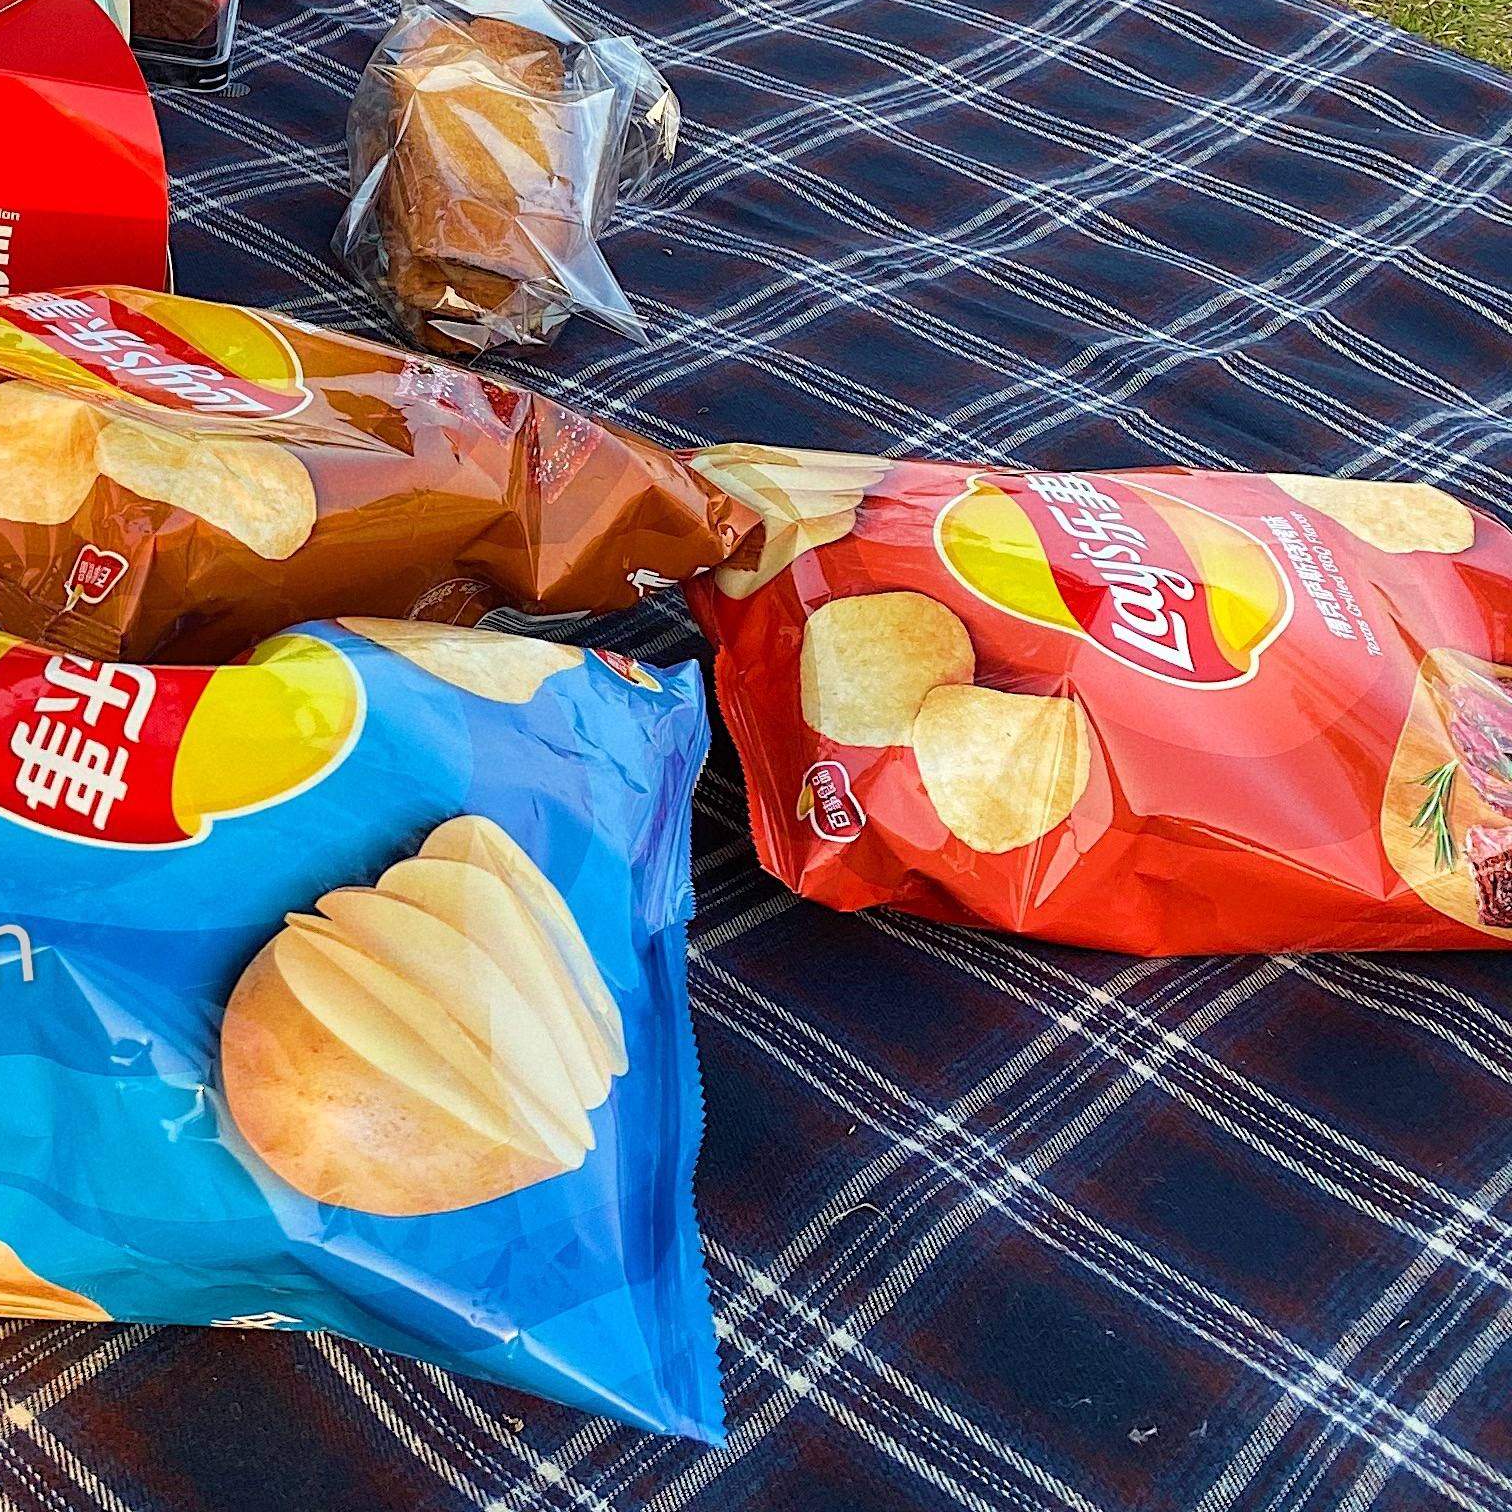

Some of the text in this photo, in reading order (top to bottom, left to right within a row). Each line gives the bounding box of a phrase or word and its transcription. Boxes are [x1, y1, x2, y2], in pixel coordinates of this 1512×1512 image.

[1070, 540, 1196, 672] Lay's
[1327, 573, 1363, 617] Grilled
[10, 652, 157, 831] 乐事
